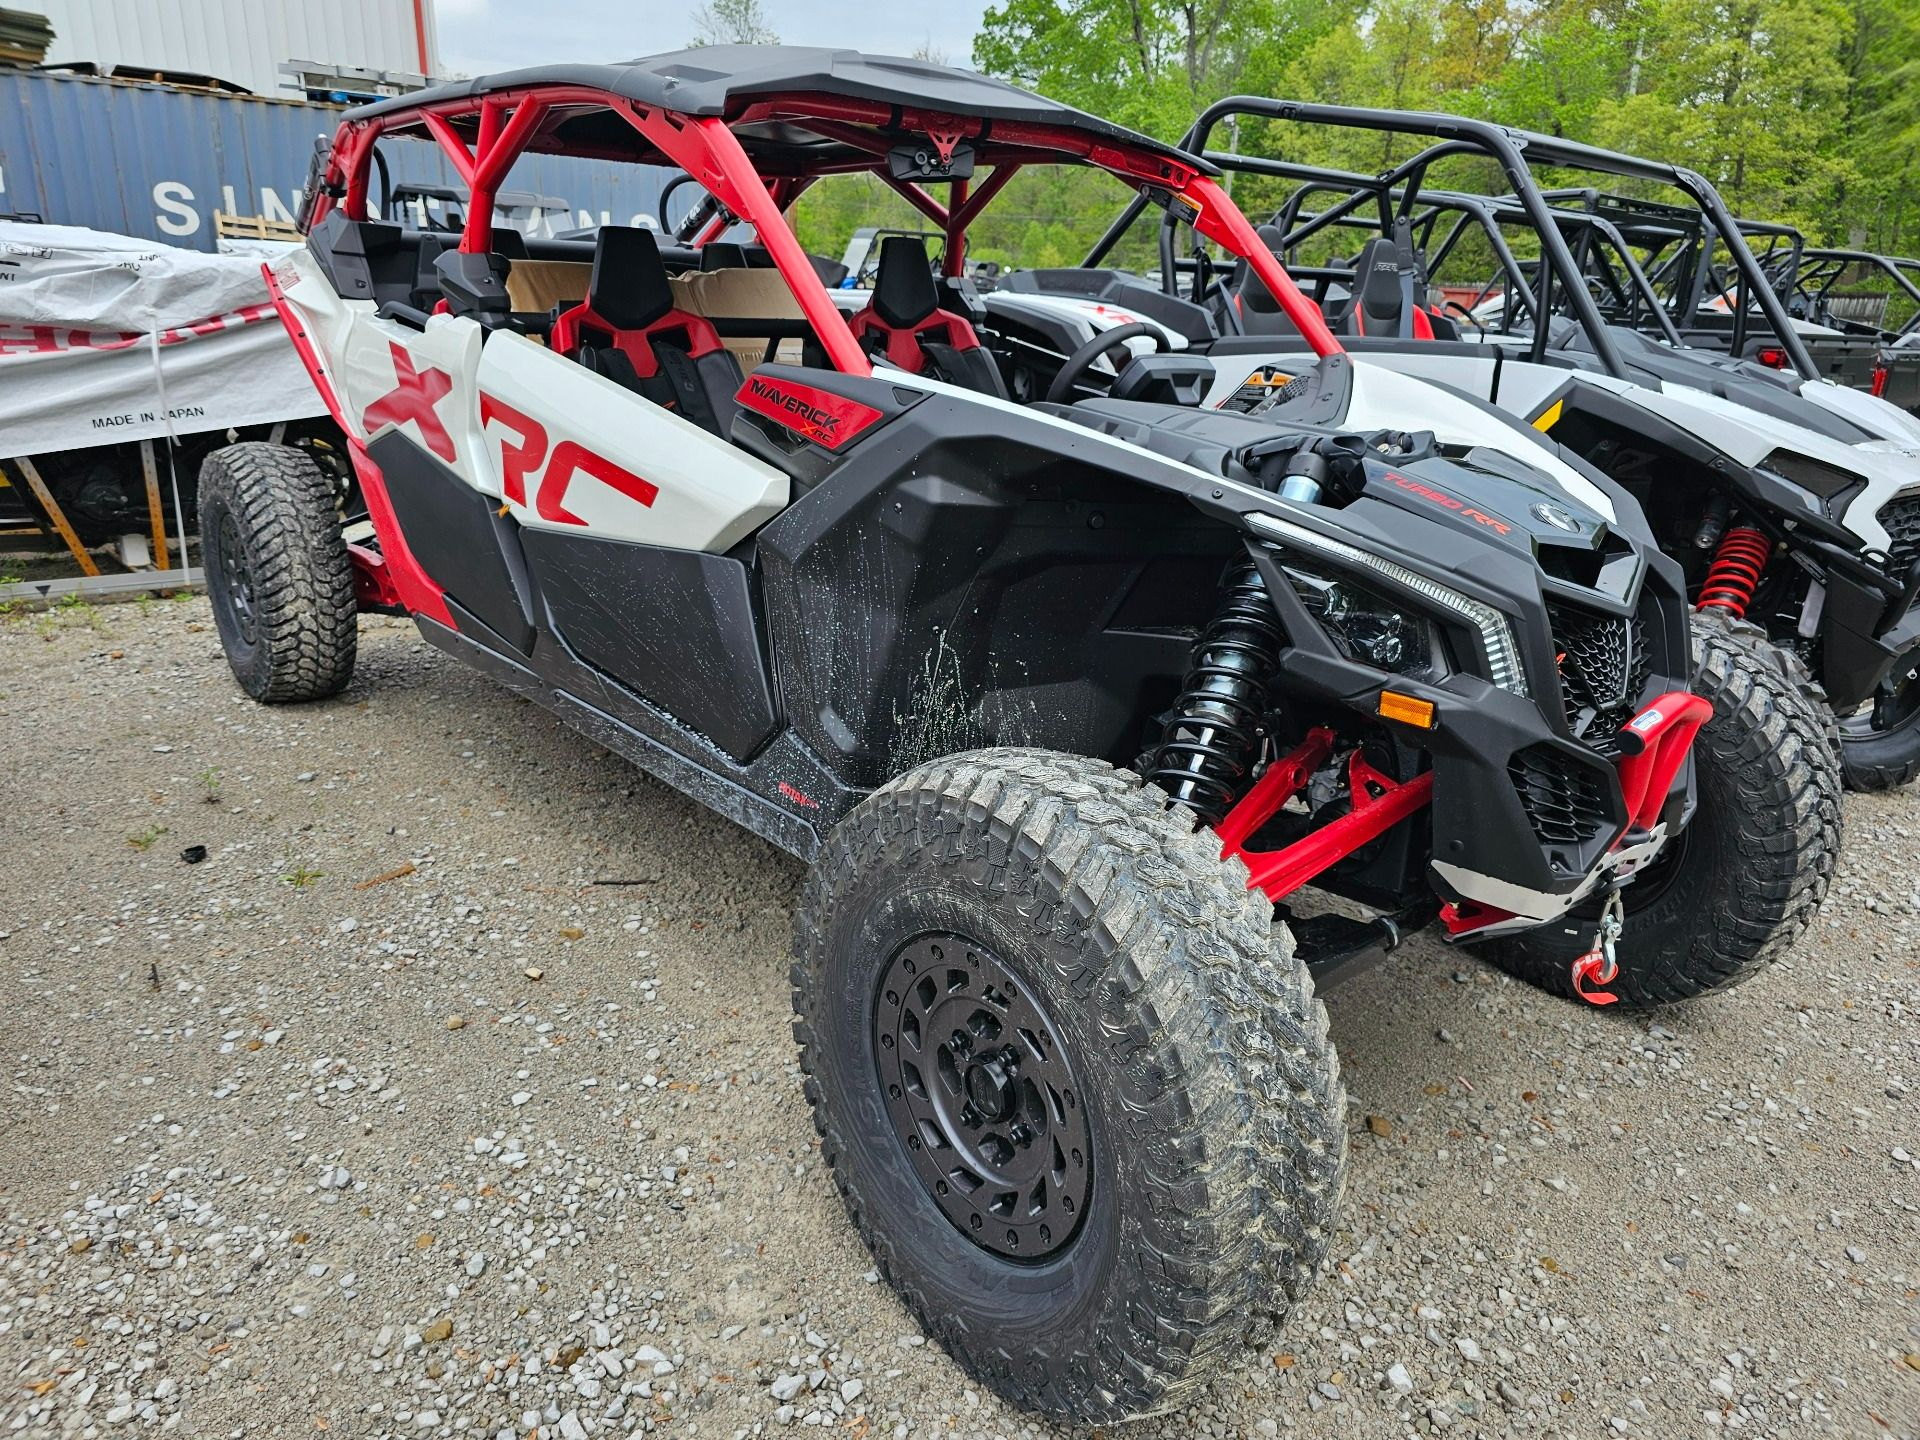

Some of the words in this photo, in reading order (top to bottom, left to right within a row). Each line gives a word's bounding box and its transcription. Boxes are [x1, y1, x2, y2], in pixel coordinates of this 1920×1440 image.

[153, 181, 660, 240] SINTANS
[92, 414, 135, 428] MADE
[140, 411, 155, 423] IN
[750, 379, 841, 433] MAVERICK
[800, 421, 834, 442] XRC
[1383, 472, 1464, 511] TURBO
[1461, 508, 1512, 536] RR
